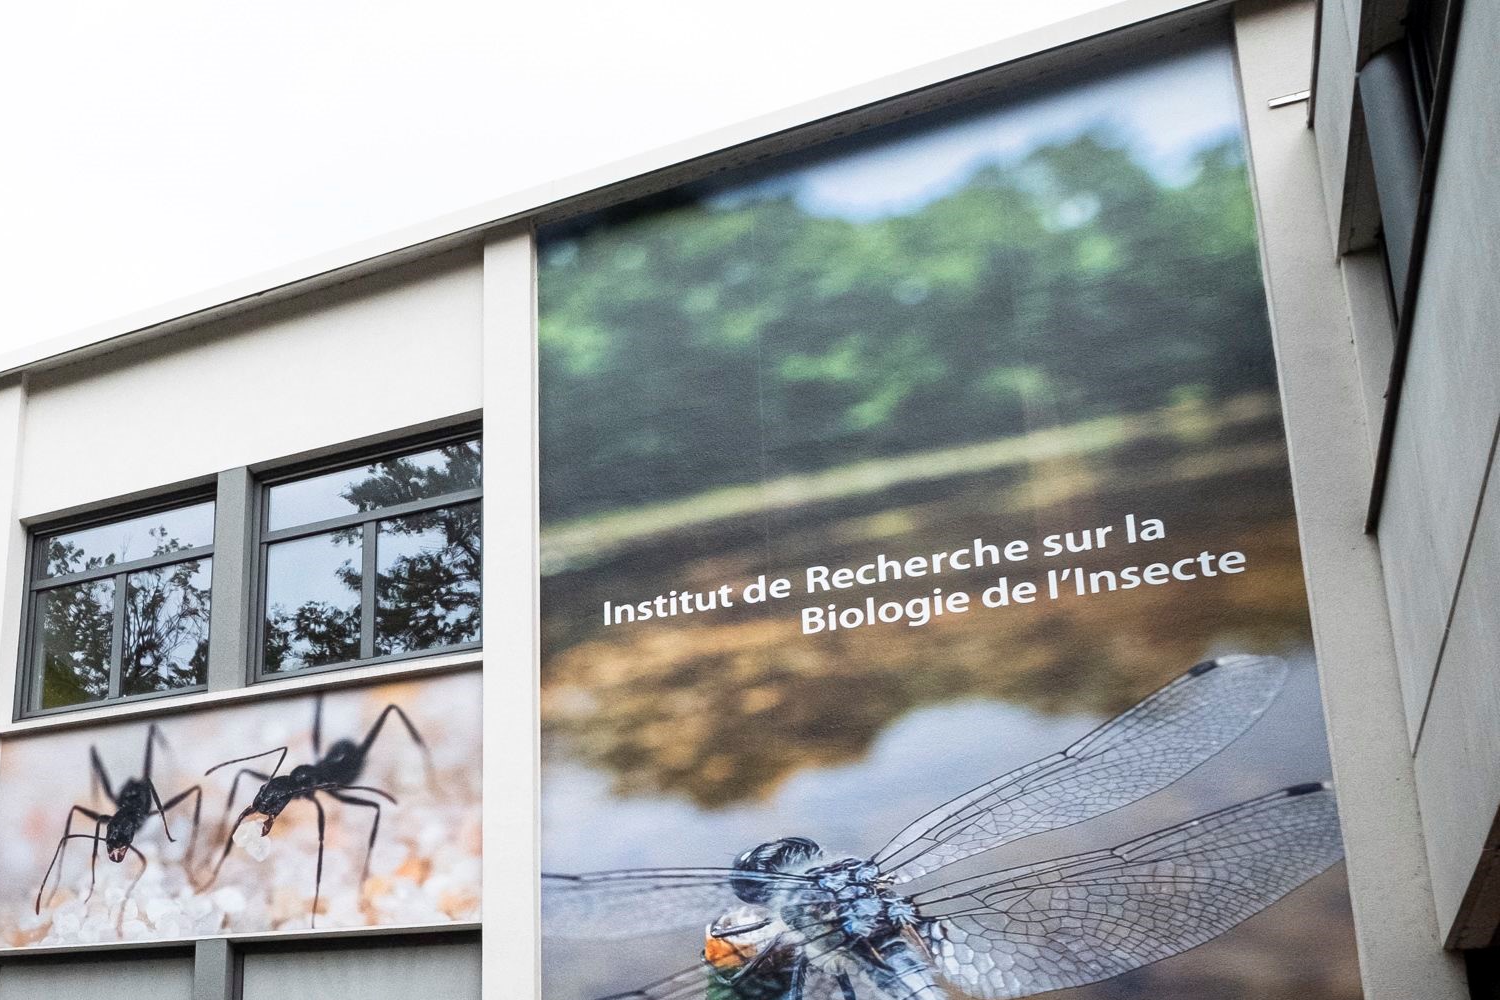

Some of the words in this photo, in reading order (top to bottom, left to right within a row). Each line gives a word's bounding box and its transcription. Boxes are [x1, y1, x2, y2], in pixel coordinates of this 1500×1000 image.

[603, 584, 735, 626] Institut
[742, 574, 792, 604] de
[806, 538, 1030, 594] Recherche
[1042, 525, 1113, 557] sur
[1125, 513, 1166, 544] la
[801, 587, 970, 635] Biologie
[981, 576, 1037, 609] de
[1047, 551, 1246, 600] l’Insecte
